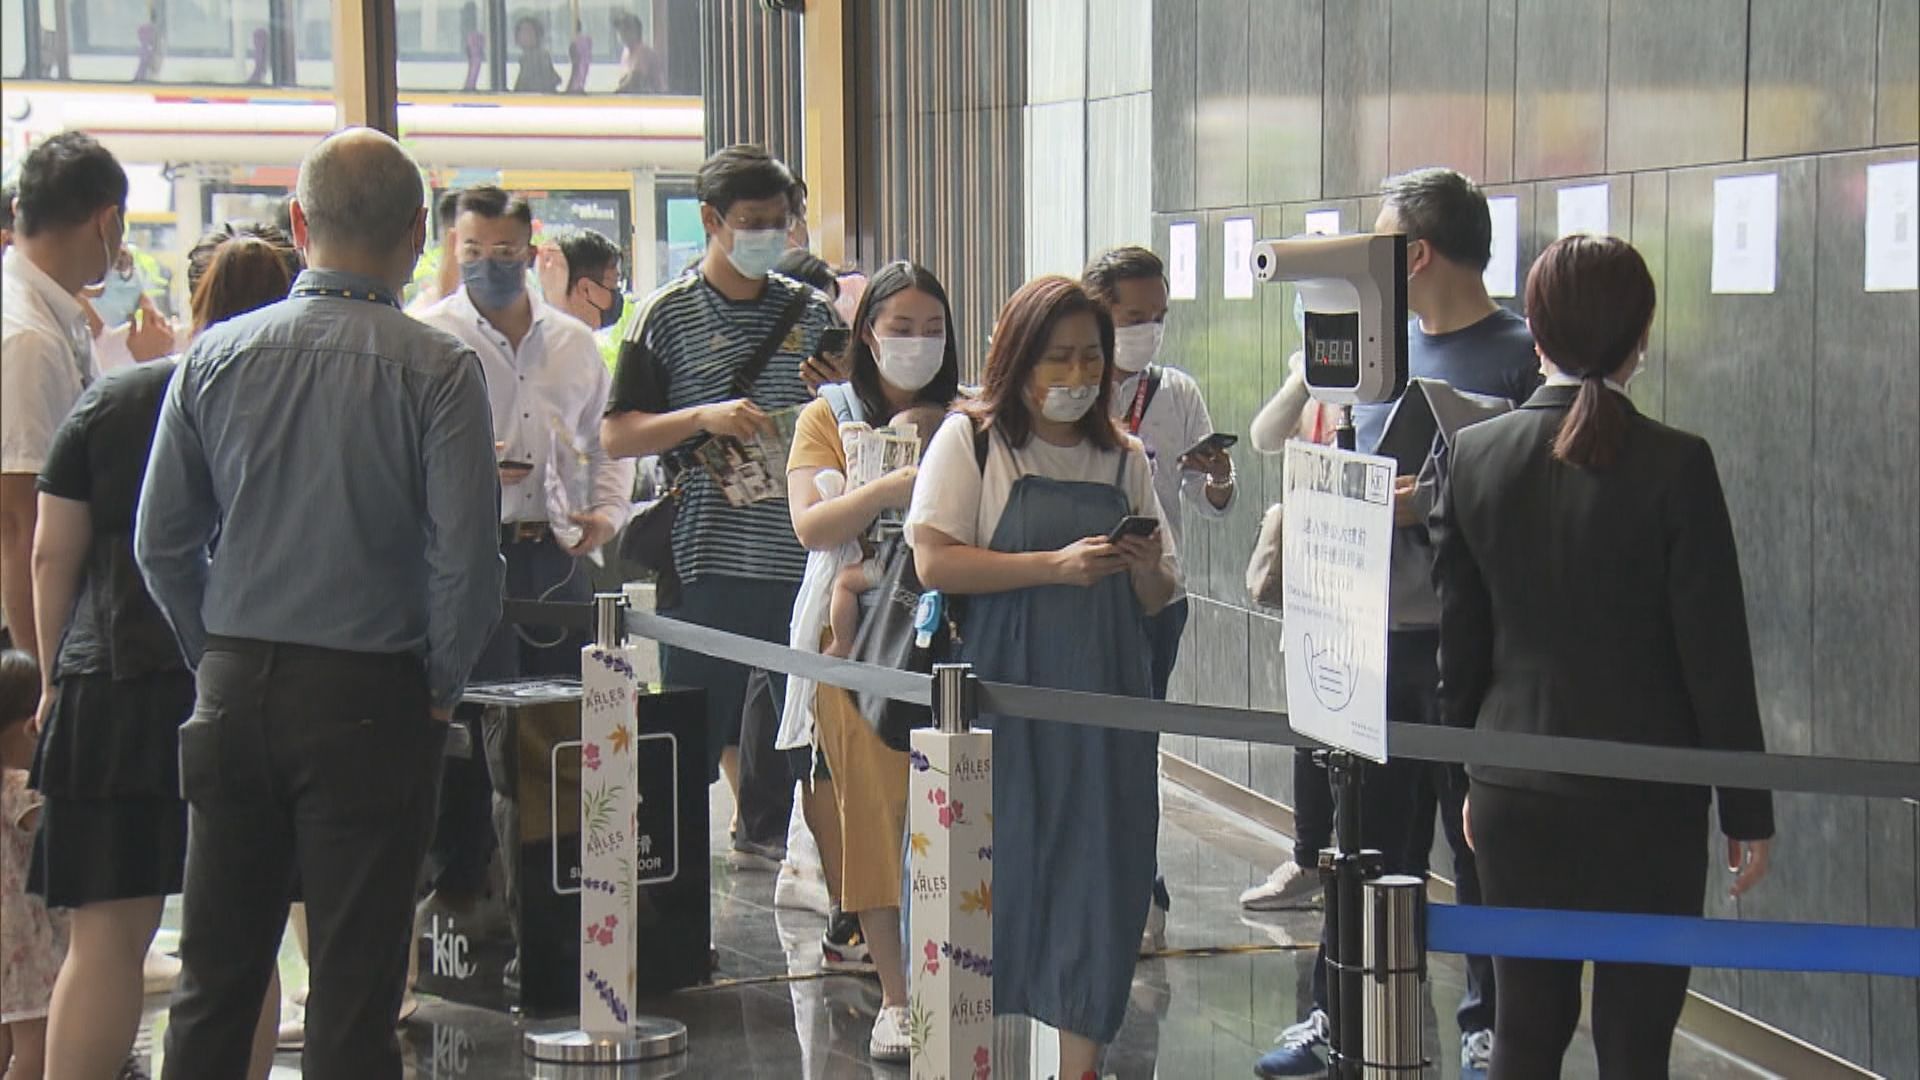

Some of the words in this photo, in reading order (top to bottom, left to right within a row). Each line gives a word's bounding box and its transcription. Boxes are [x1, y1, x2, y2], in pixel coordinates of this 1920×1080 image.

[586, 687, 625, 709] ARLES
[954, 758, 991, 777] ARLES
[586, 830, 624, 856] ARLES
[912, 875, 947, 893] ARLES
[431, 913, 470, 980] kic
[951, 998, 992, 1018] ARLES
